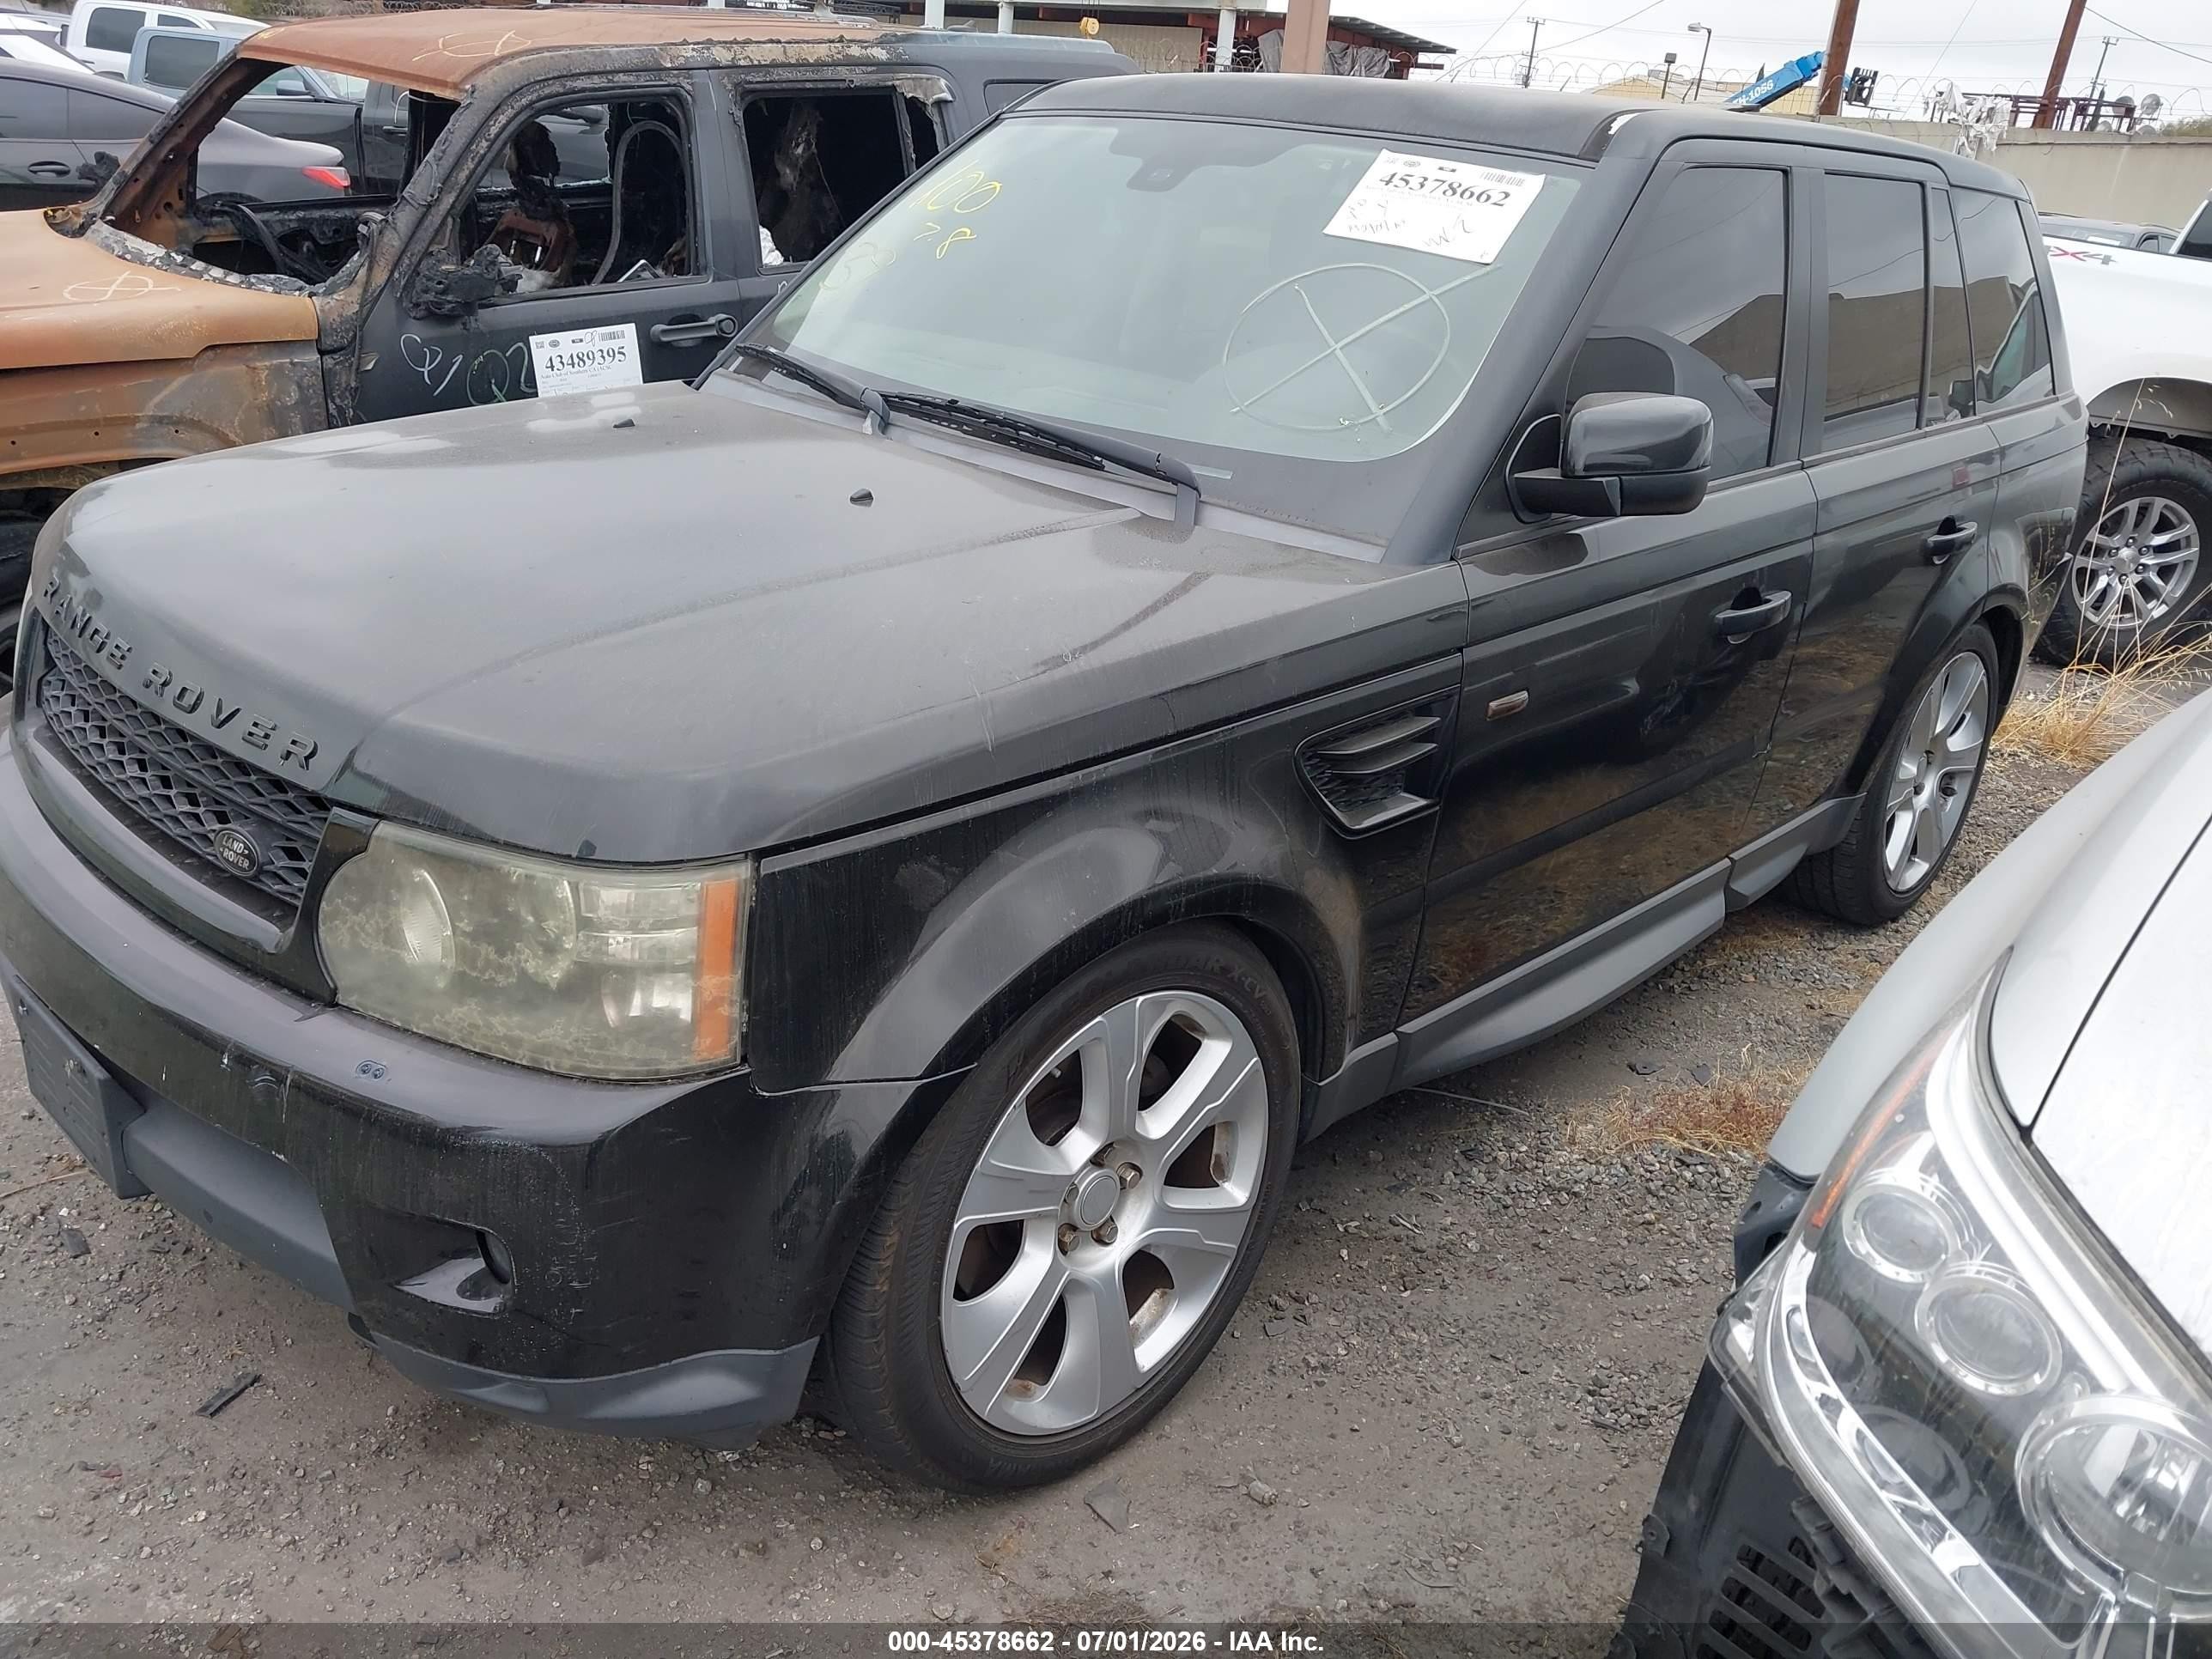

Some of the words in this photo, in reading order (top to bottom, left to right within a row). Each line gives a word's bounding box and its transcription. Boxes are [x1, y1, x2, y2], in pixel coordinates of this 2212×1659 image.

[1379, 172, 1511, 207] 45378662
[544, 345, 627, 372] 43489395
[43, 574, 133, 671] RANGE
[142, 662, 319, 771] ROVER
[222, 835, 245, 854] LAND
[222, 848, 250, 870] ROVER
